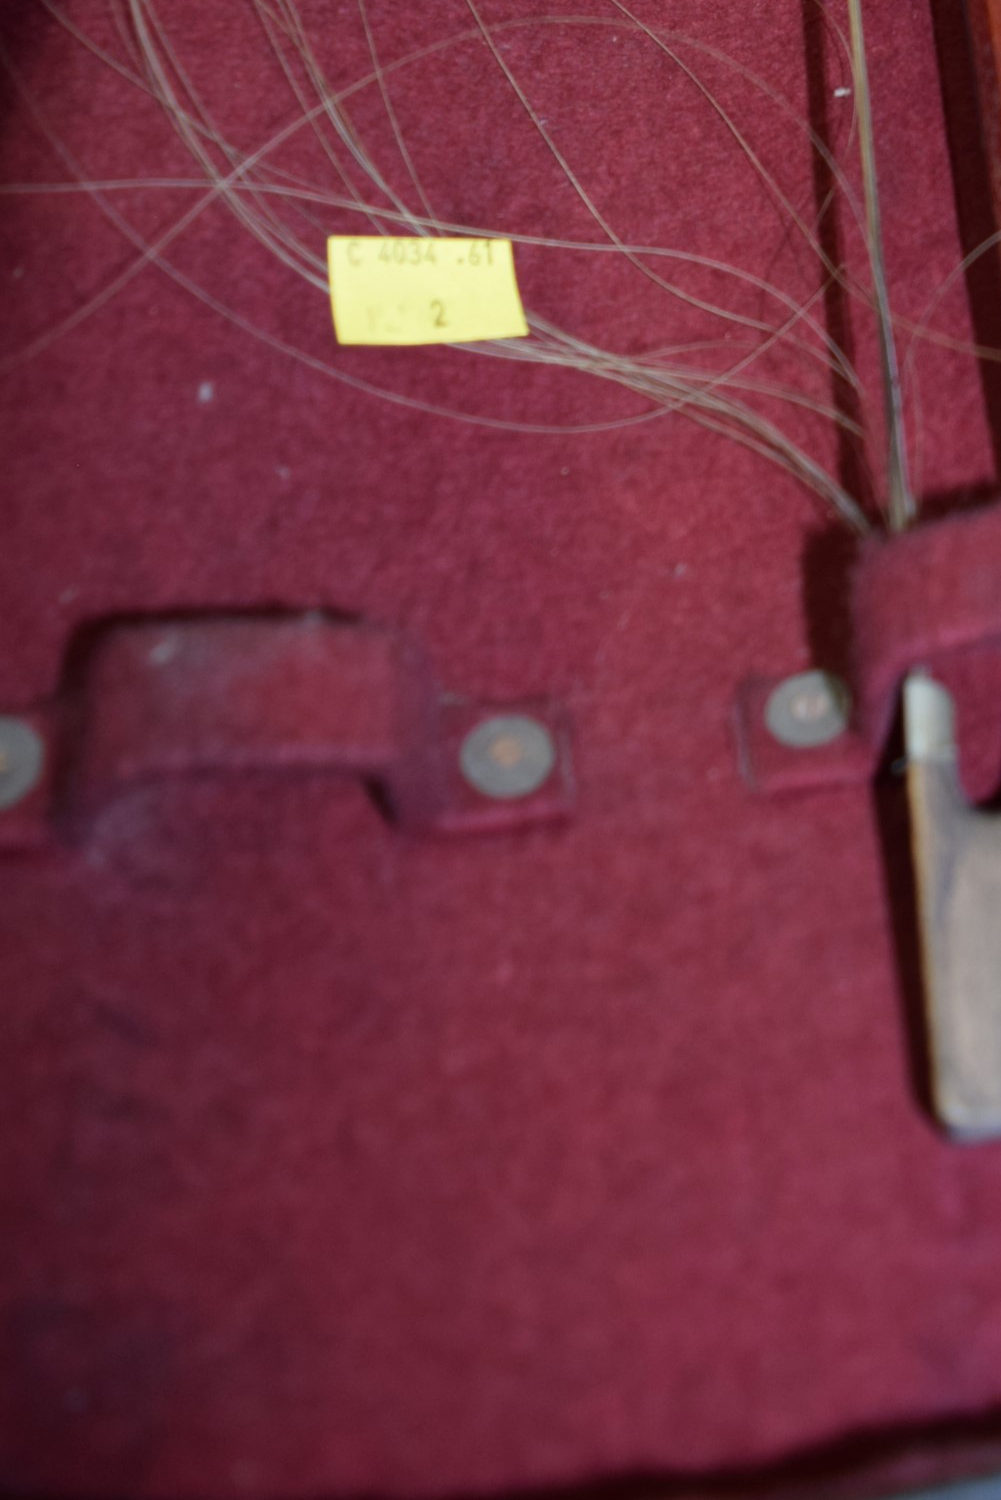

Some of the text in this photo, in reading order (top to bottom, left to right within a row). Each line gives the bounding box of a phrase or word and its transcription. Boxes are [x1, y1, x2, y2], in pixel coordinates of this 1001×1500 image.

[346, 240, 362, 267] C
[378, 241, 438, 266] 4034
[429, 298, 448, 329] 2
